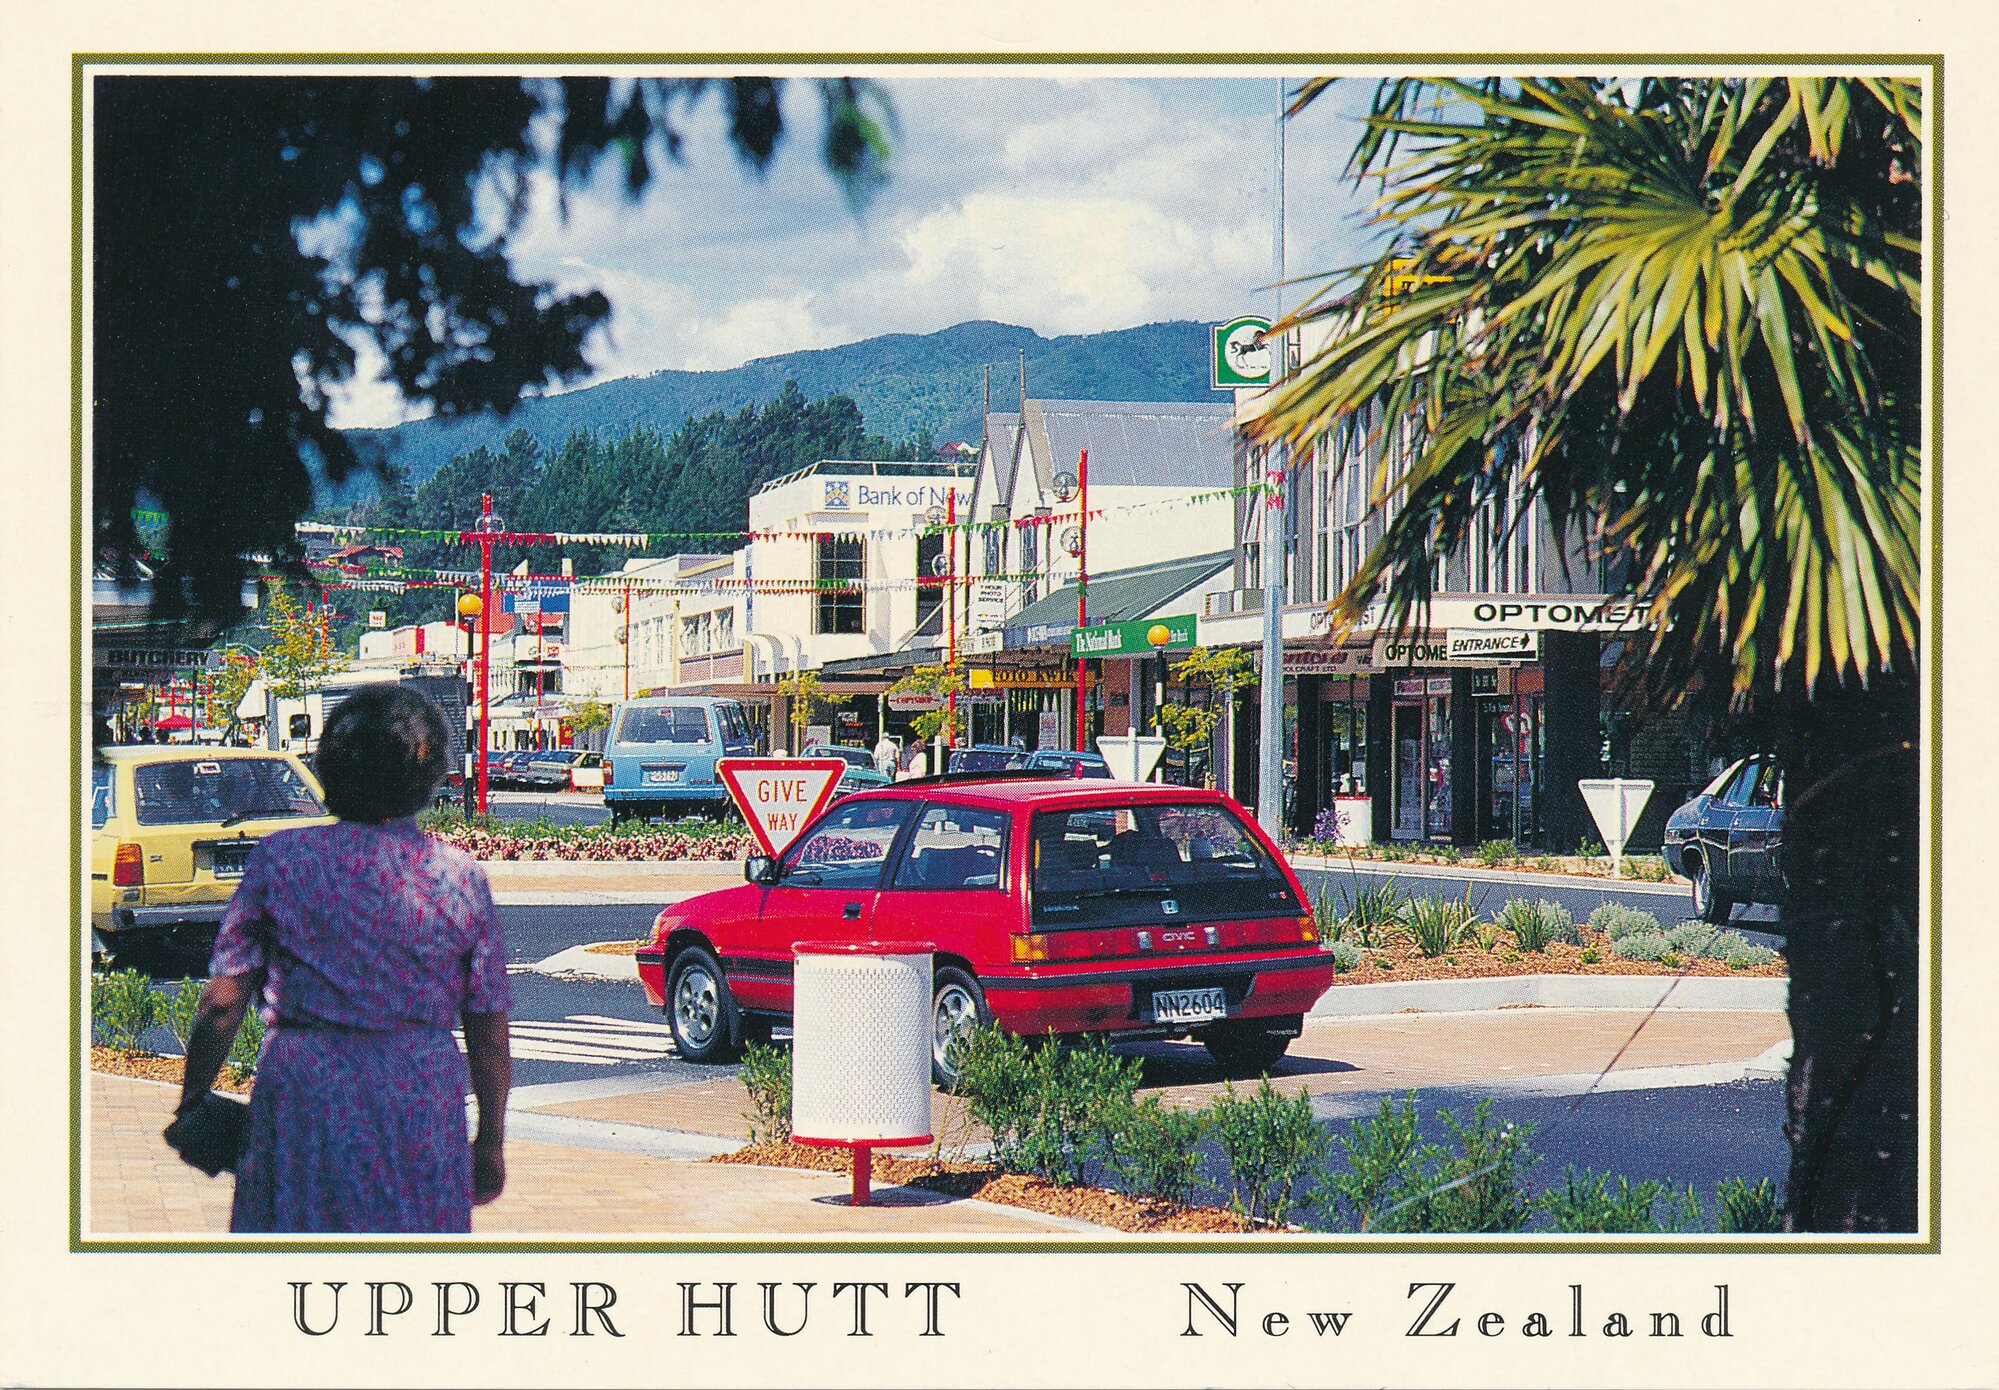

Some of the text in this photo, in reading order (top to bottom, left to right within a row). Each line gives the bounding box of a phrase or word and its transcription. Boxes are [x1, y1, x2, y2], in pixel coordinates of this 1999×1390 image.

[858, 485, 971, 505] Bank of Nw
[1474, 604, 1652, 623] OPTOMET
[1086, 630, 1108, 651] National
[1452, 637, 1519, 652] ENTRANCE
[1385, 644, 1447, 661] OPTOME
[757, 779, 808, 803] GIVE
[767, 812, 798, 831] WAY
[1162, 931, 1195, 942] CIVIC
[1155, 992, 1224, 1017] NN2604
